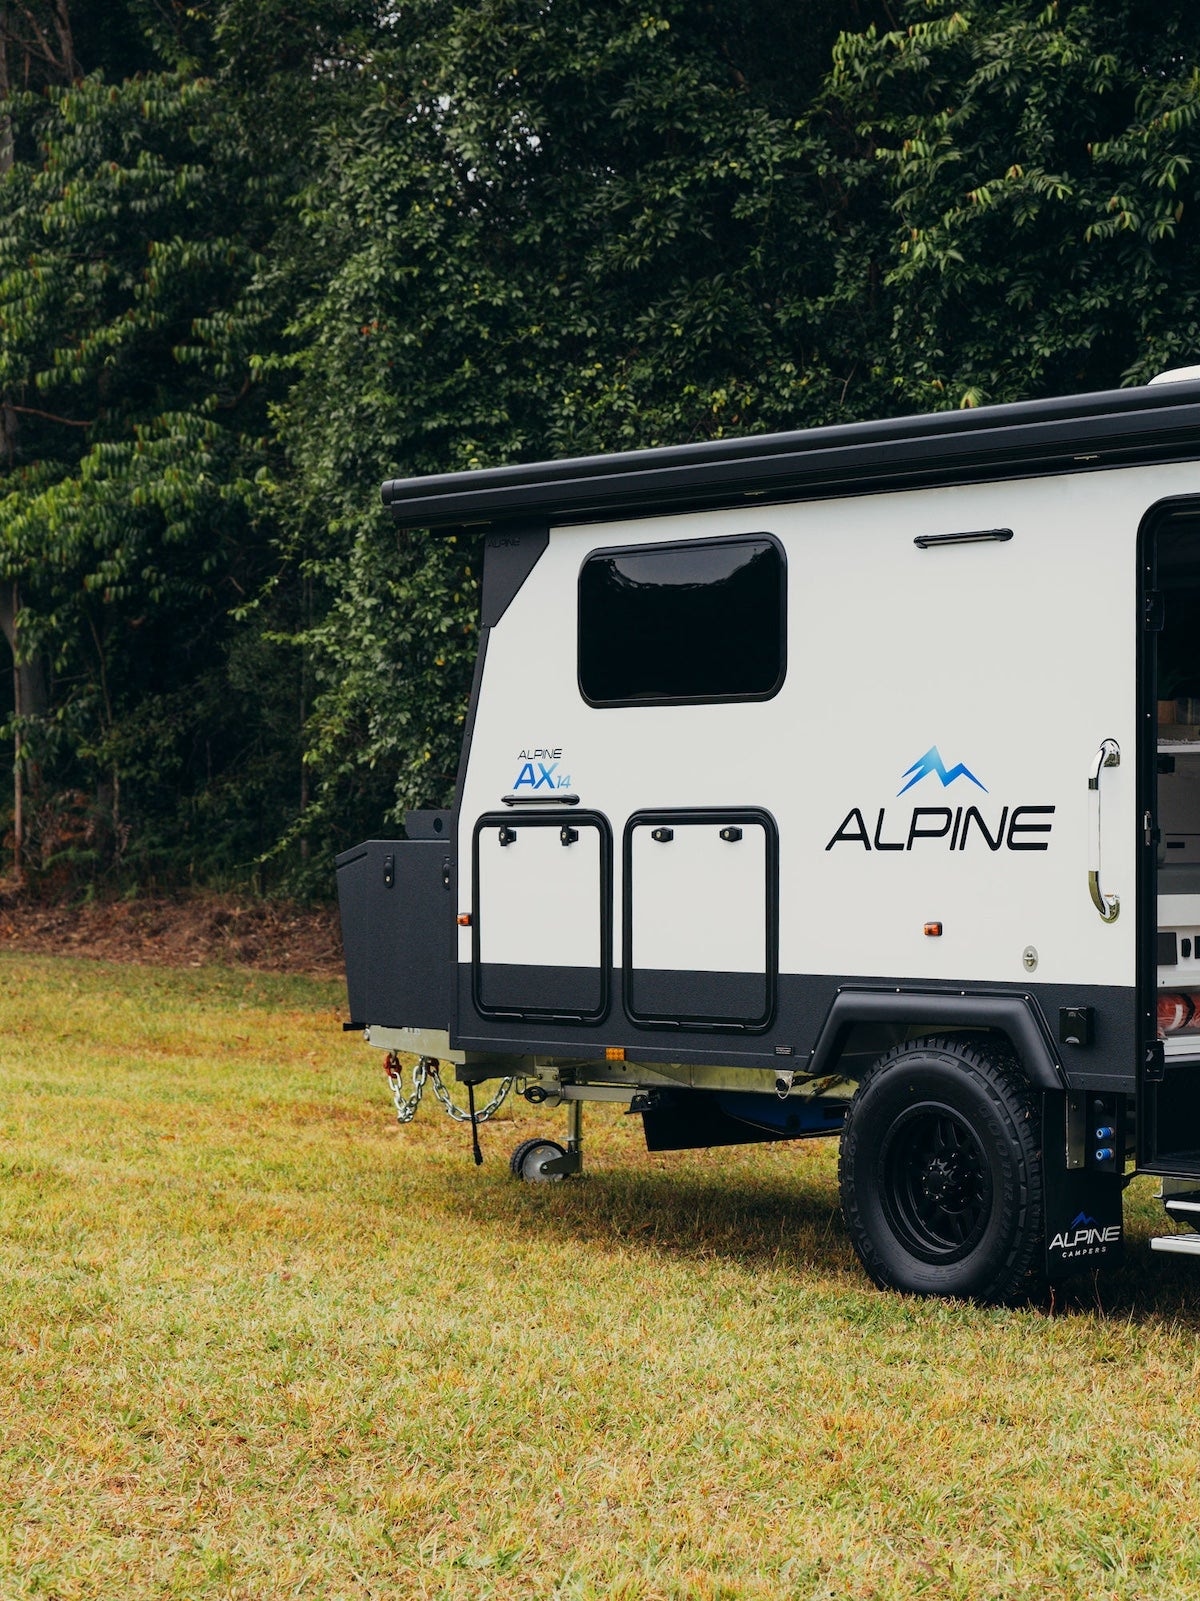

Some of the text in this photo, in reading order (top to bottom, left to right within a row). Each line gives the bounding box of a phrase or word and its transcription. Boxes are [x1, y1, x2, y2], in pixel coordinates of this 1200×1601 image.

[517, 748, 563, 760] ALPINE
[825, 805, 1056, 851] ALPINE
[1048, 1225, 1121, 1251] ALPINE
[1062, 1246, 1107, 1259] CAMPERS
